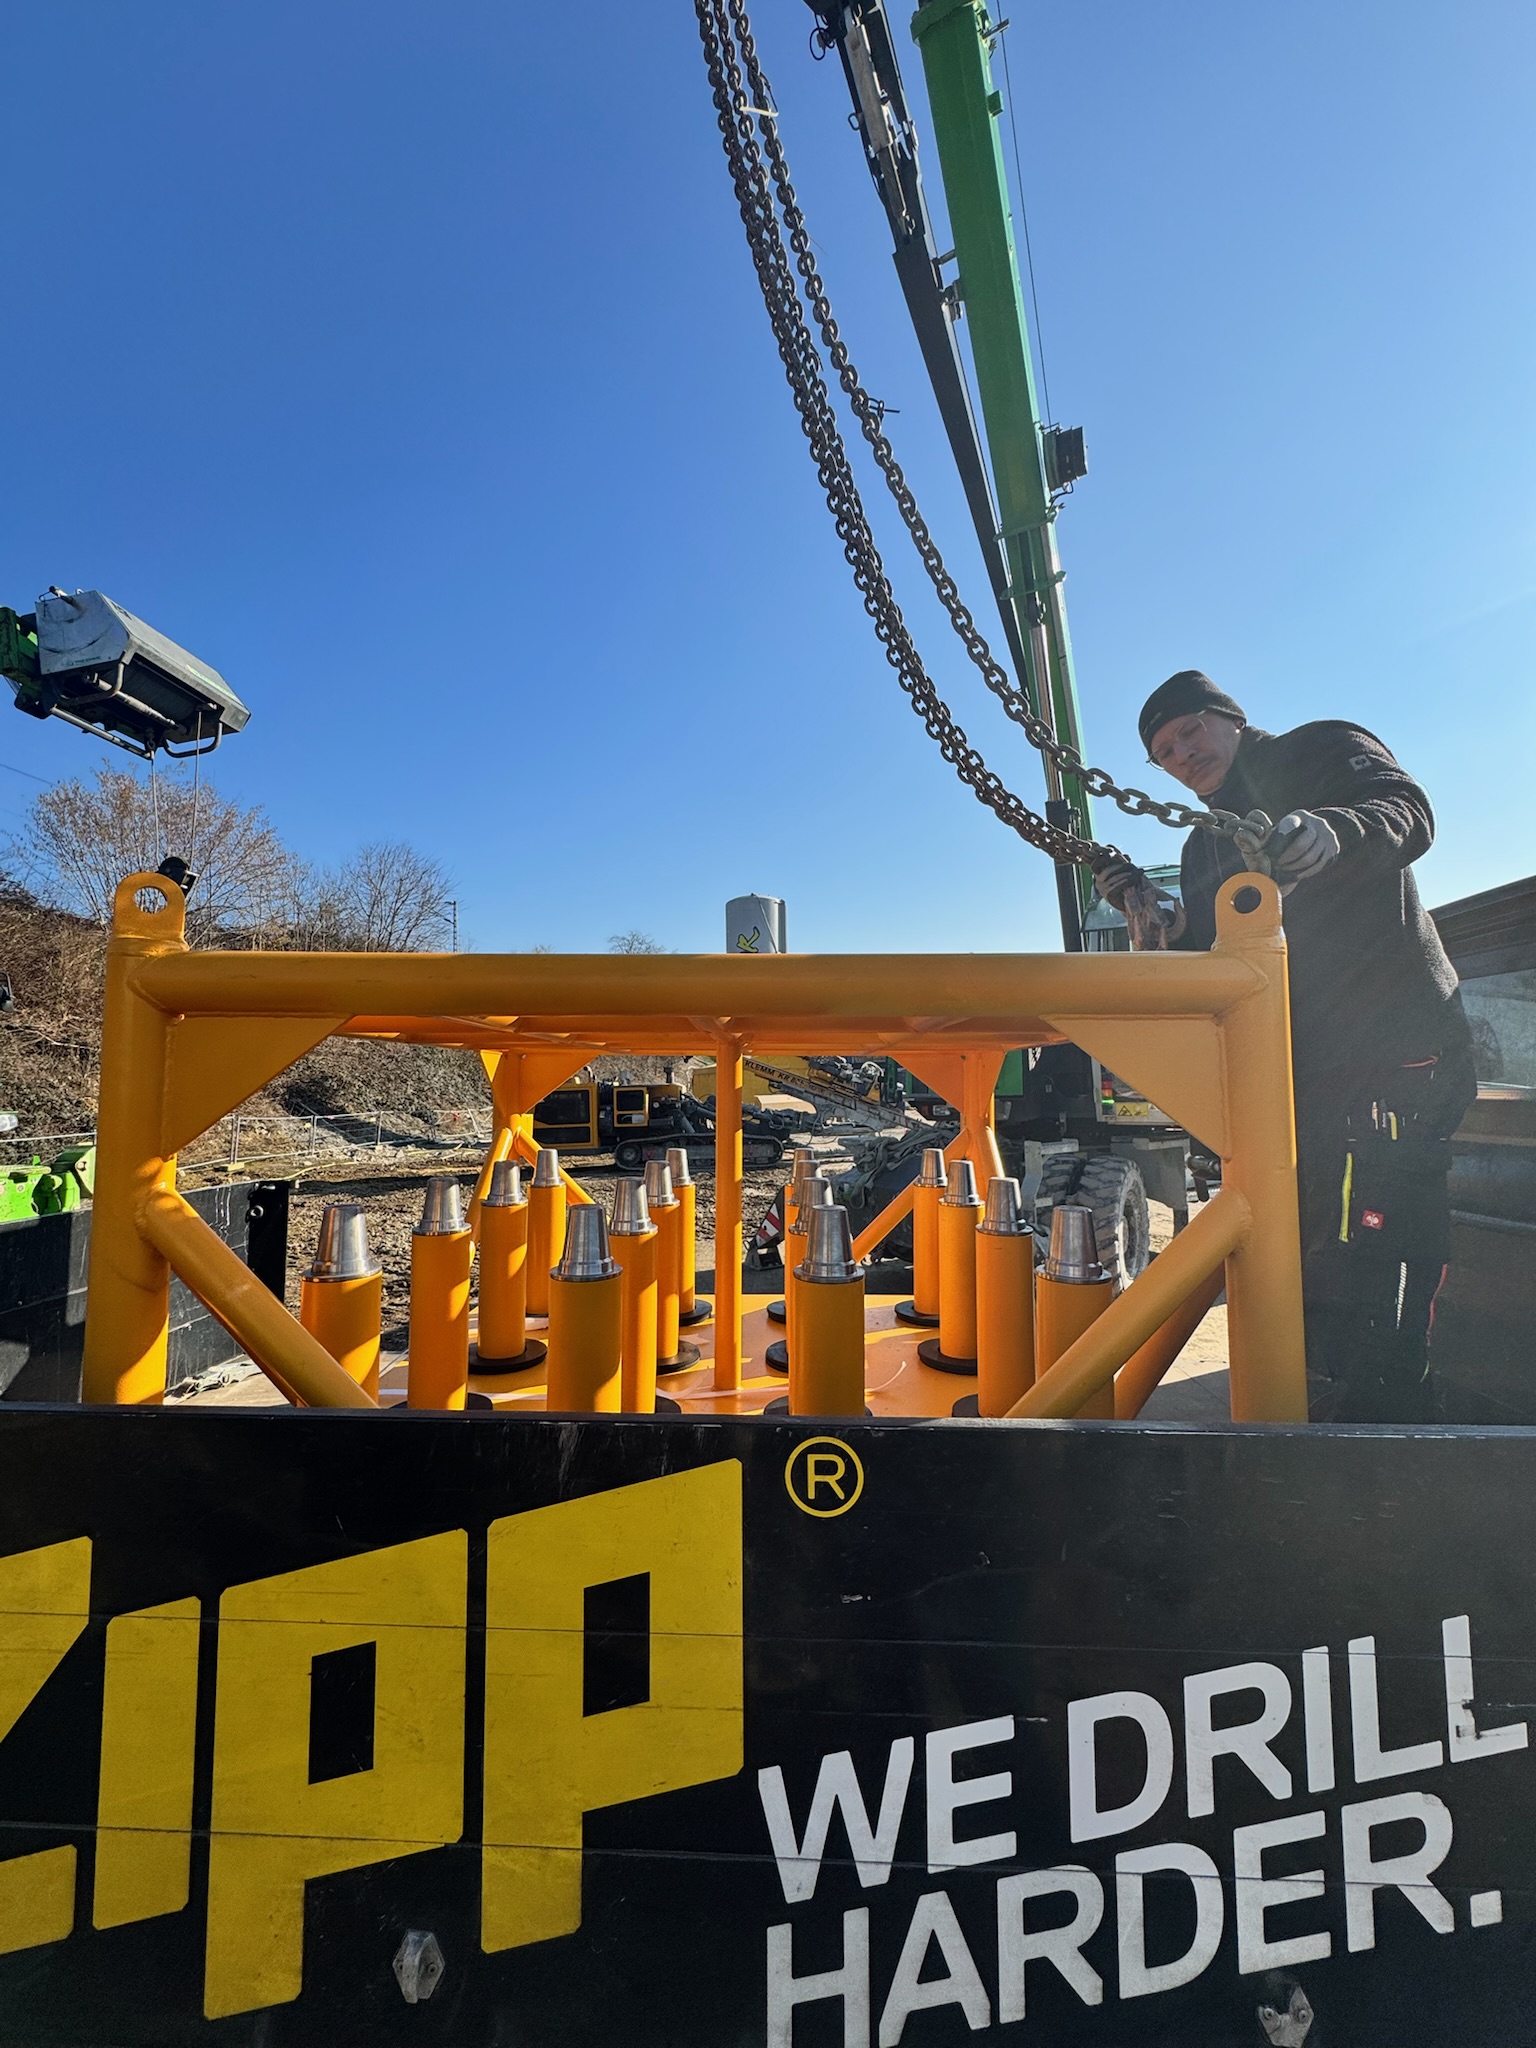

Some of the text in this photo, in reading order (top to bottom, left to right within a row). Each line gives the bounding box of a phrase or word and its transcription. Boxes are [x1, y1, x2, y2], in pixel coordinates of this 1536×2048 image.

[745, 1060, 775, 1076] KLEMM
[758, 1614, 1529, 1904] WE DRILL
[766, 1791, 1502, 2048] HARDER.
